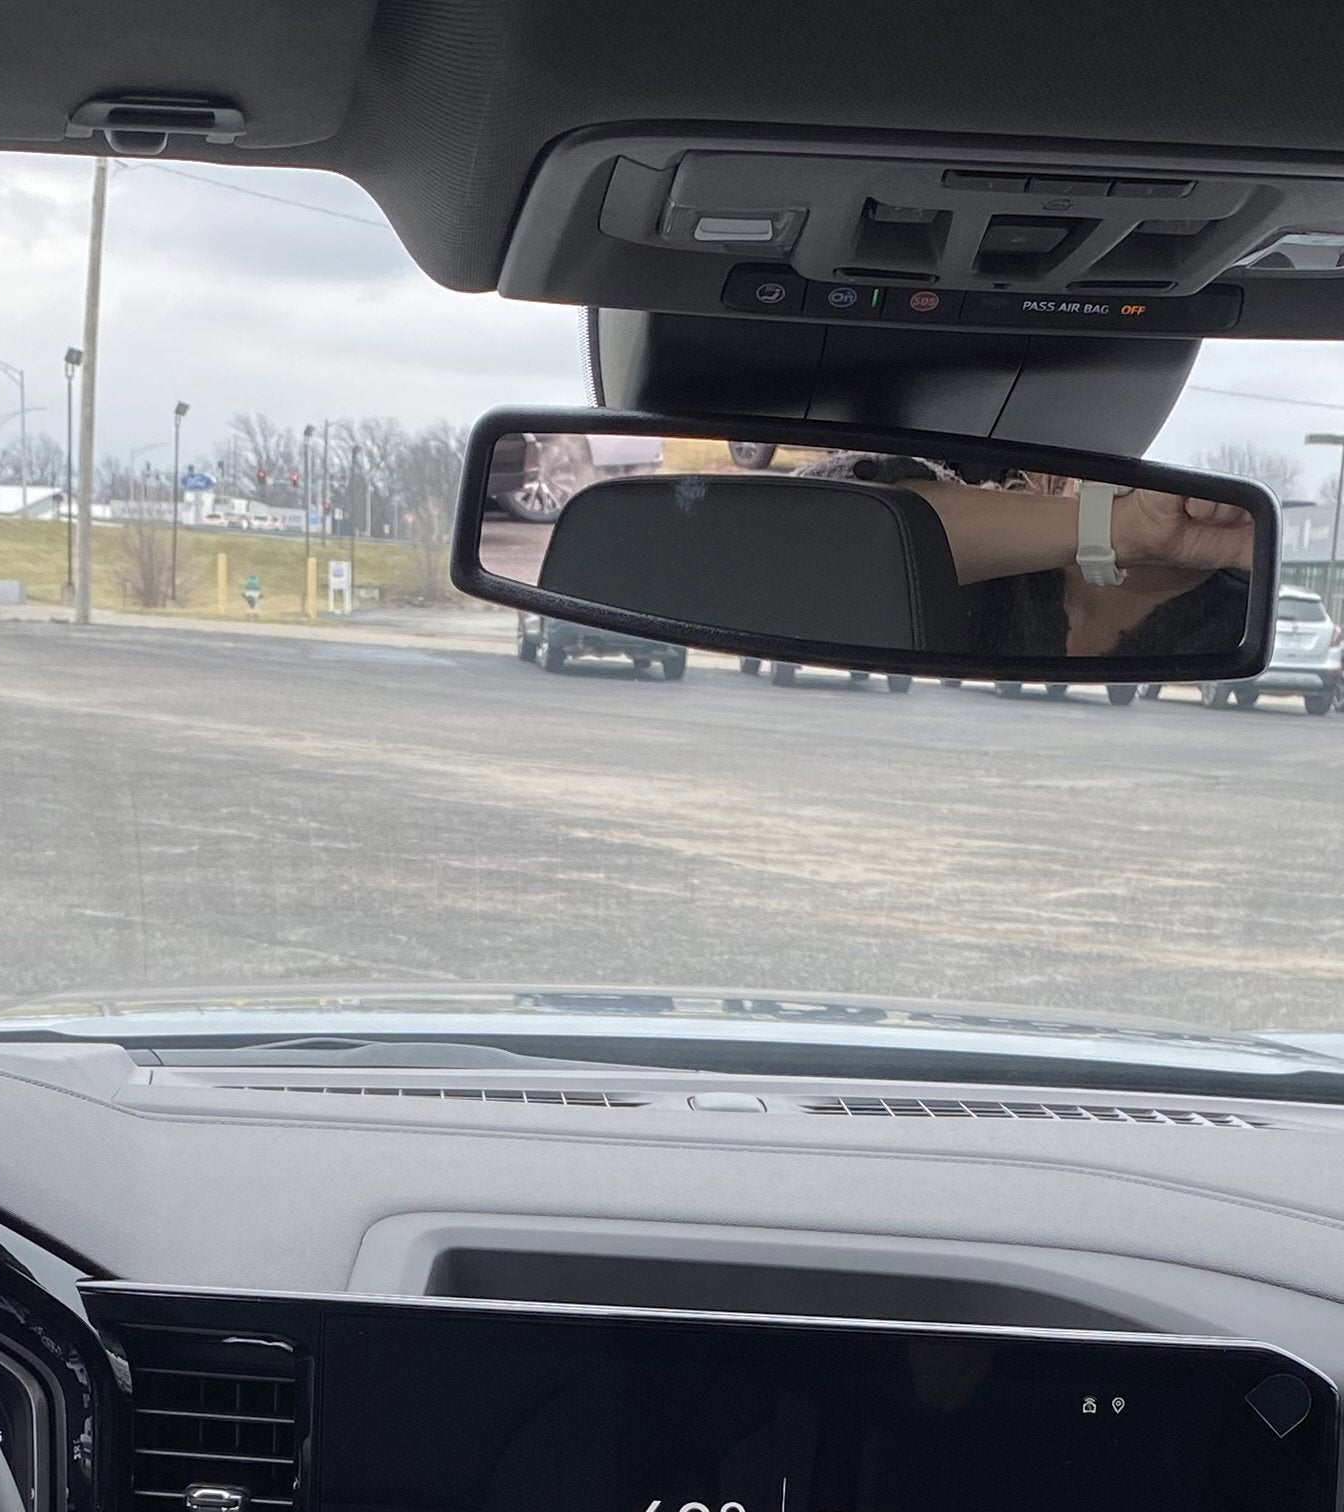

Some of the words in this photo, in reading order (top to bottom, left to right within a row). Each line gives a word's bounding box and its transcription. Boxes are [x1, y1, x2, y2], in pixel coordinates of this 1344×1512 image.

[1022, 300, 1056, 312] PASS
[1058, 302, 1081, 313] AIR
[1083, 303, 1110, 314] BAG
[1120, 305, 1146, 316] OFF
